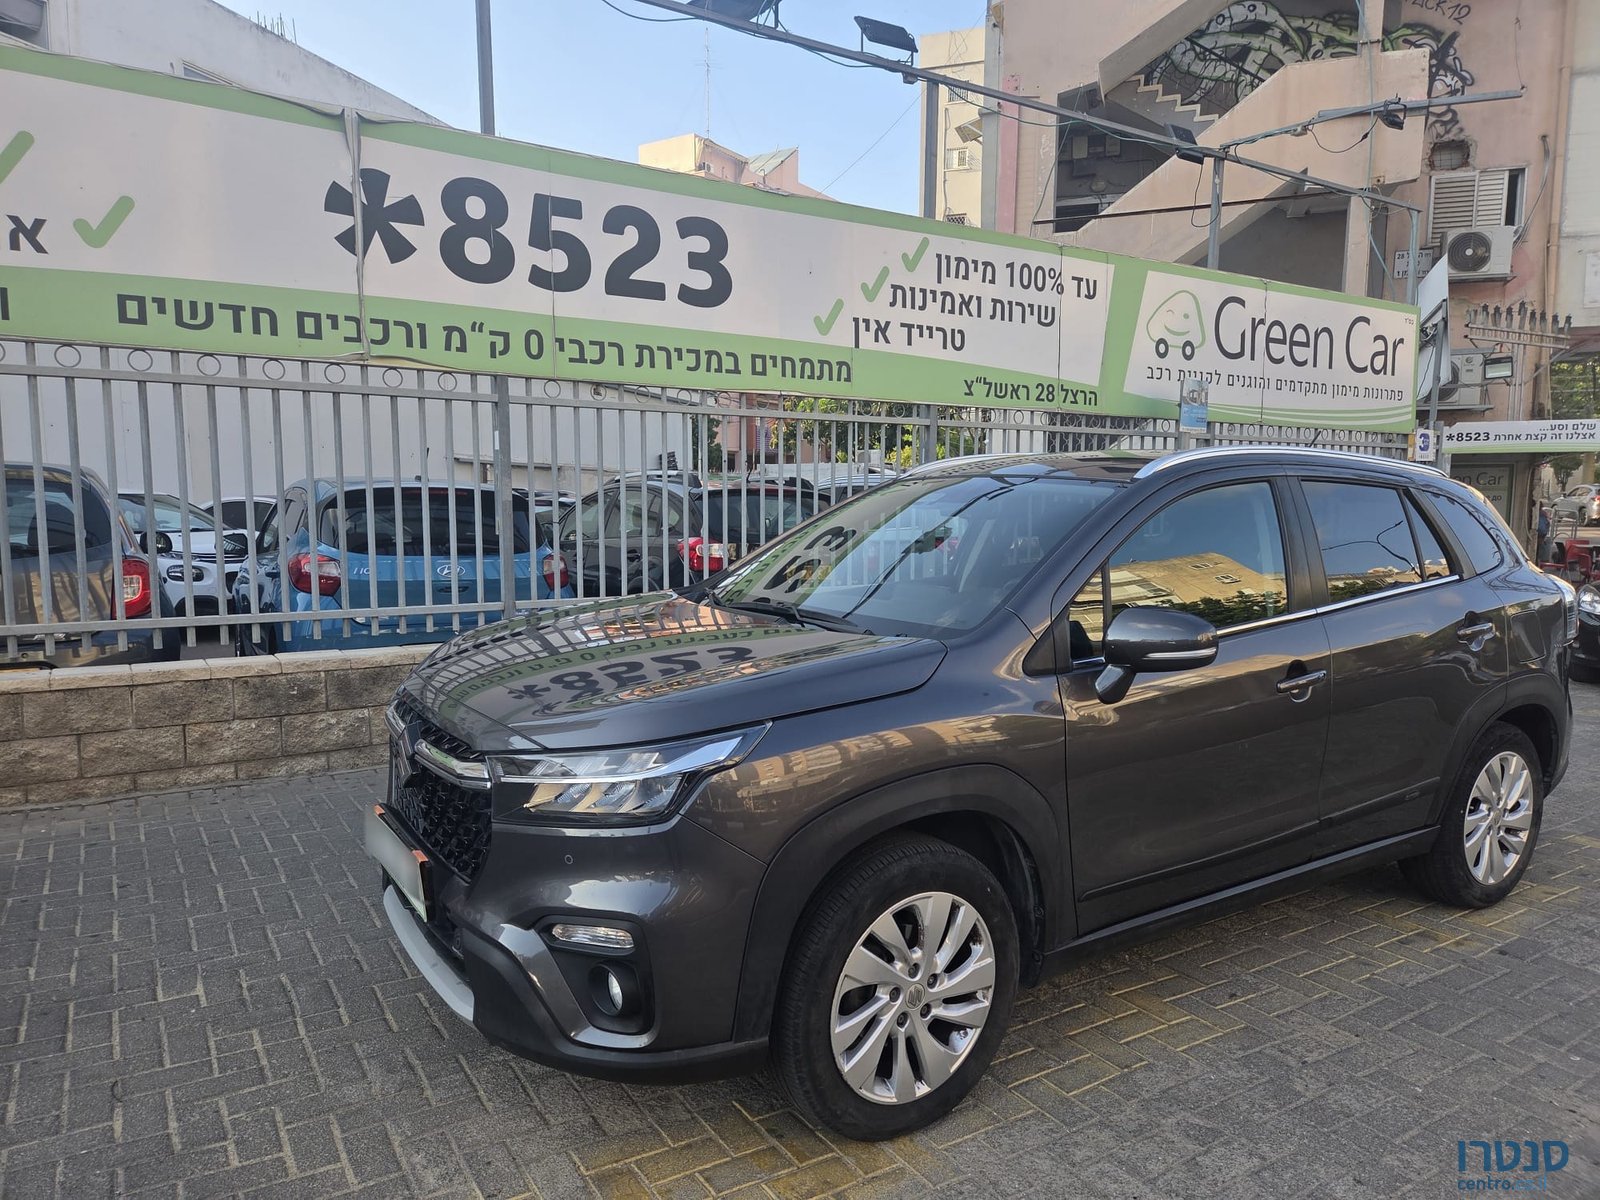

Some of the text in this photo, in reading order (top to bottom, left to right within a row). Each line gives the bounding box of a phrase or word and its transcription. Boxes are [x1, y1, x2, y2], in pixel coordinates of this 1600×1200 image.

[935, 253, 1097, 300] עד 100% מימון
[116, 293, 279, 337] חדשים
[889, 284, 1056, 327] שירות ואמינות
[296, 310, 428, 350] ורכבים
[852, 317, 966, 352] טרייד אין
[1214, 296, 1405, 377] Green Car
[524, 329, 544, 360] 0
[554, 337, 625, 367] רכבי
[634, 344, 742, 375] במכירת
[750, 353, 852, 383] מתמחים
[1146, 365, 1172, 381] רכב
[1227, 374, 1270, 390] והוגנים
[1035, 382, 1055, 403] 28
[1060, 383, 1098, 407] הרצל
[1275, 378, 1327, 397] מתקדמים
[1332, 383, 1360, 399] מימון
[1363, 387, 1404, 402] פתרונות
[1494, 433, 1522, 441] אחרת
[1525, 432, 1547, 442] קצת
[1550, 432, 1562, 440] זה
[1565, 430, 1596, 440] אצלנו
[1572, 422, 1597, 431] שלם
[1476, 472, 1504, 486] Car
